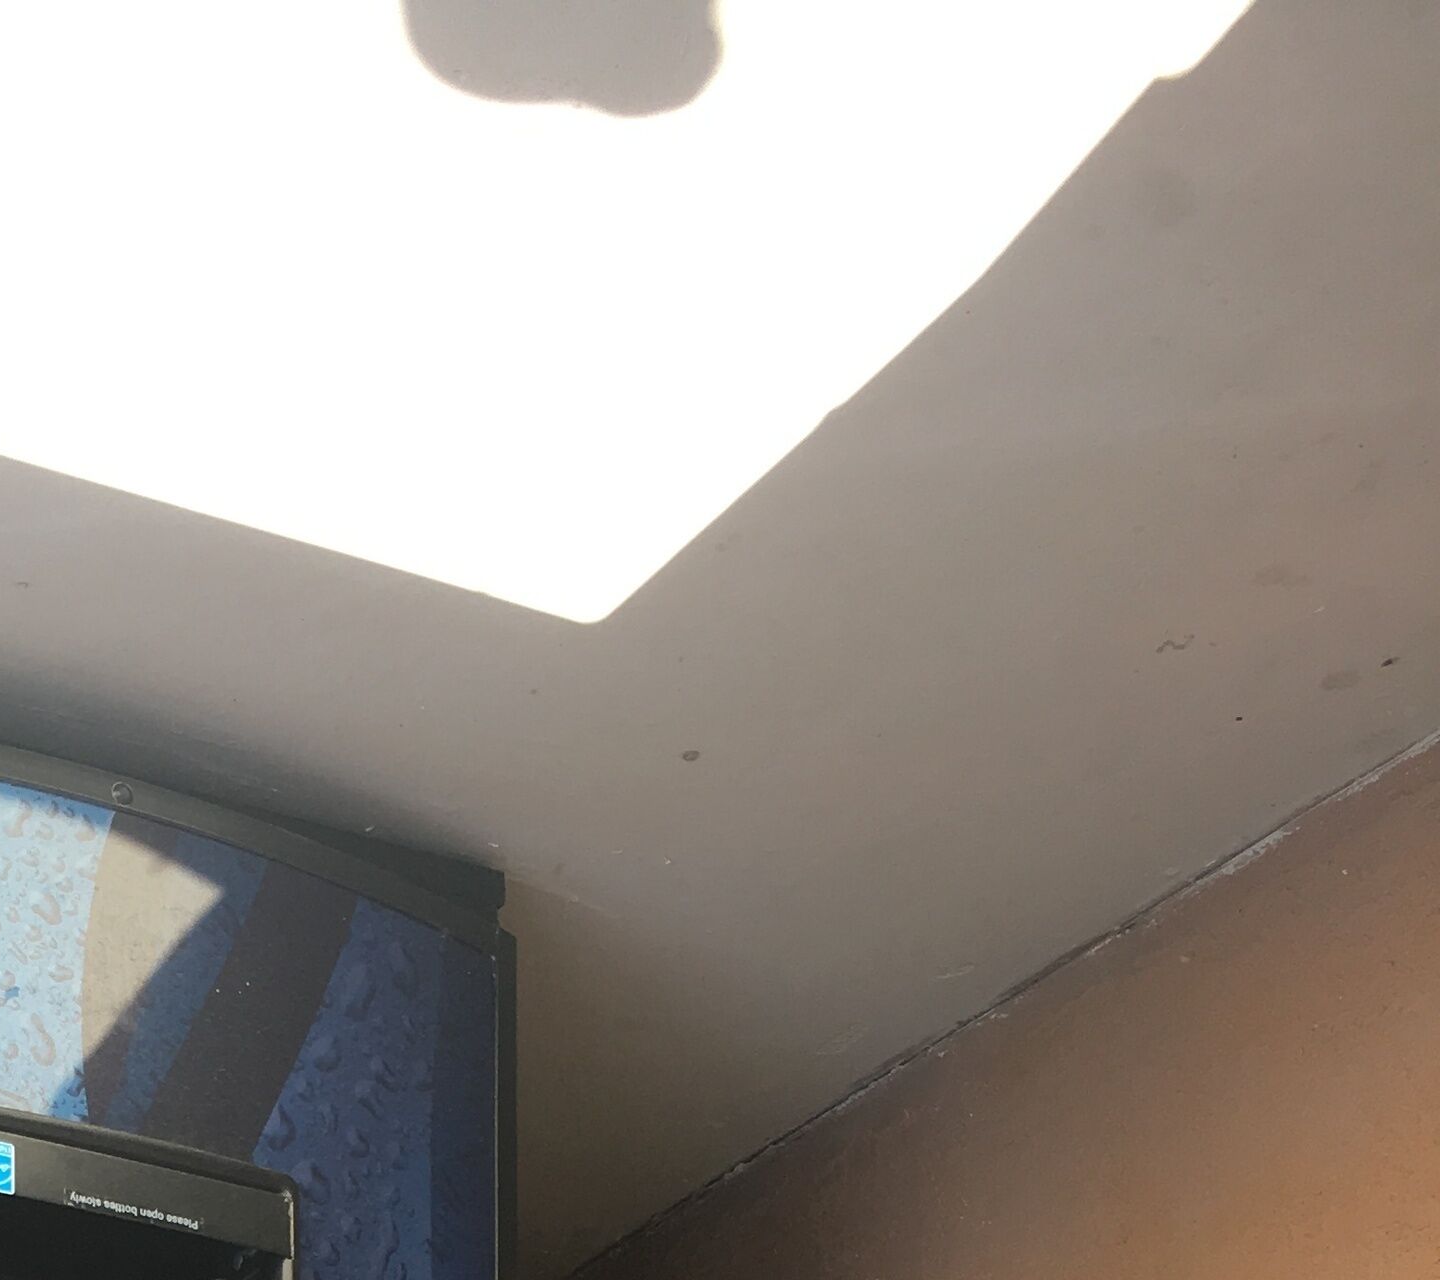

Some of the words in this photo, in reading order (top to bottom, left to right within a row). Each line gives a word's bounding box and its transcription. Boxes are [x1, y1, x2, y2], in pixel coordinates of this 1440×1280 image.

[70, 1191, 101, 1207] slowly
[104, 1200, 138, 1216] bottles
[140, 1208, 164, 1220] open
[166, 1214, 198, 1230] Please
